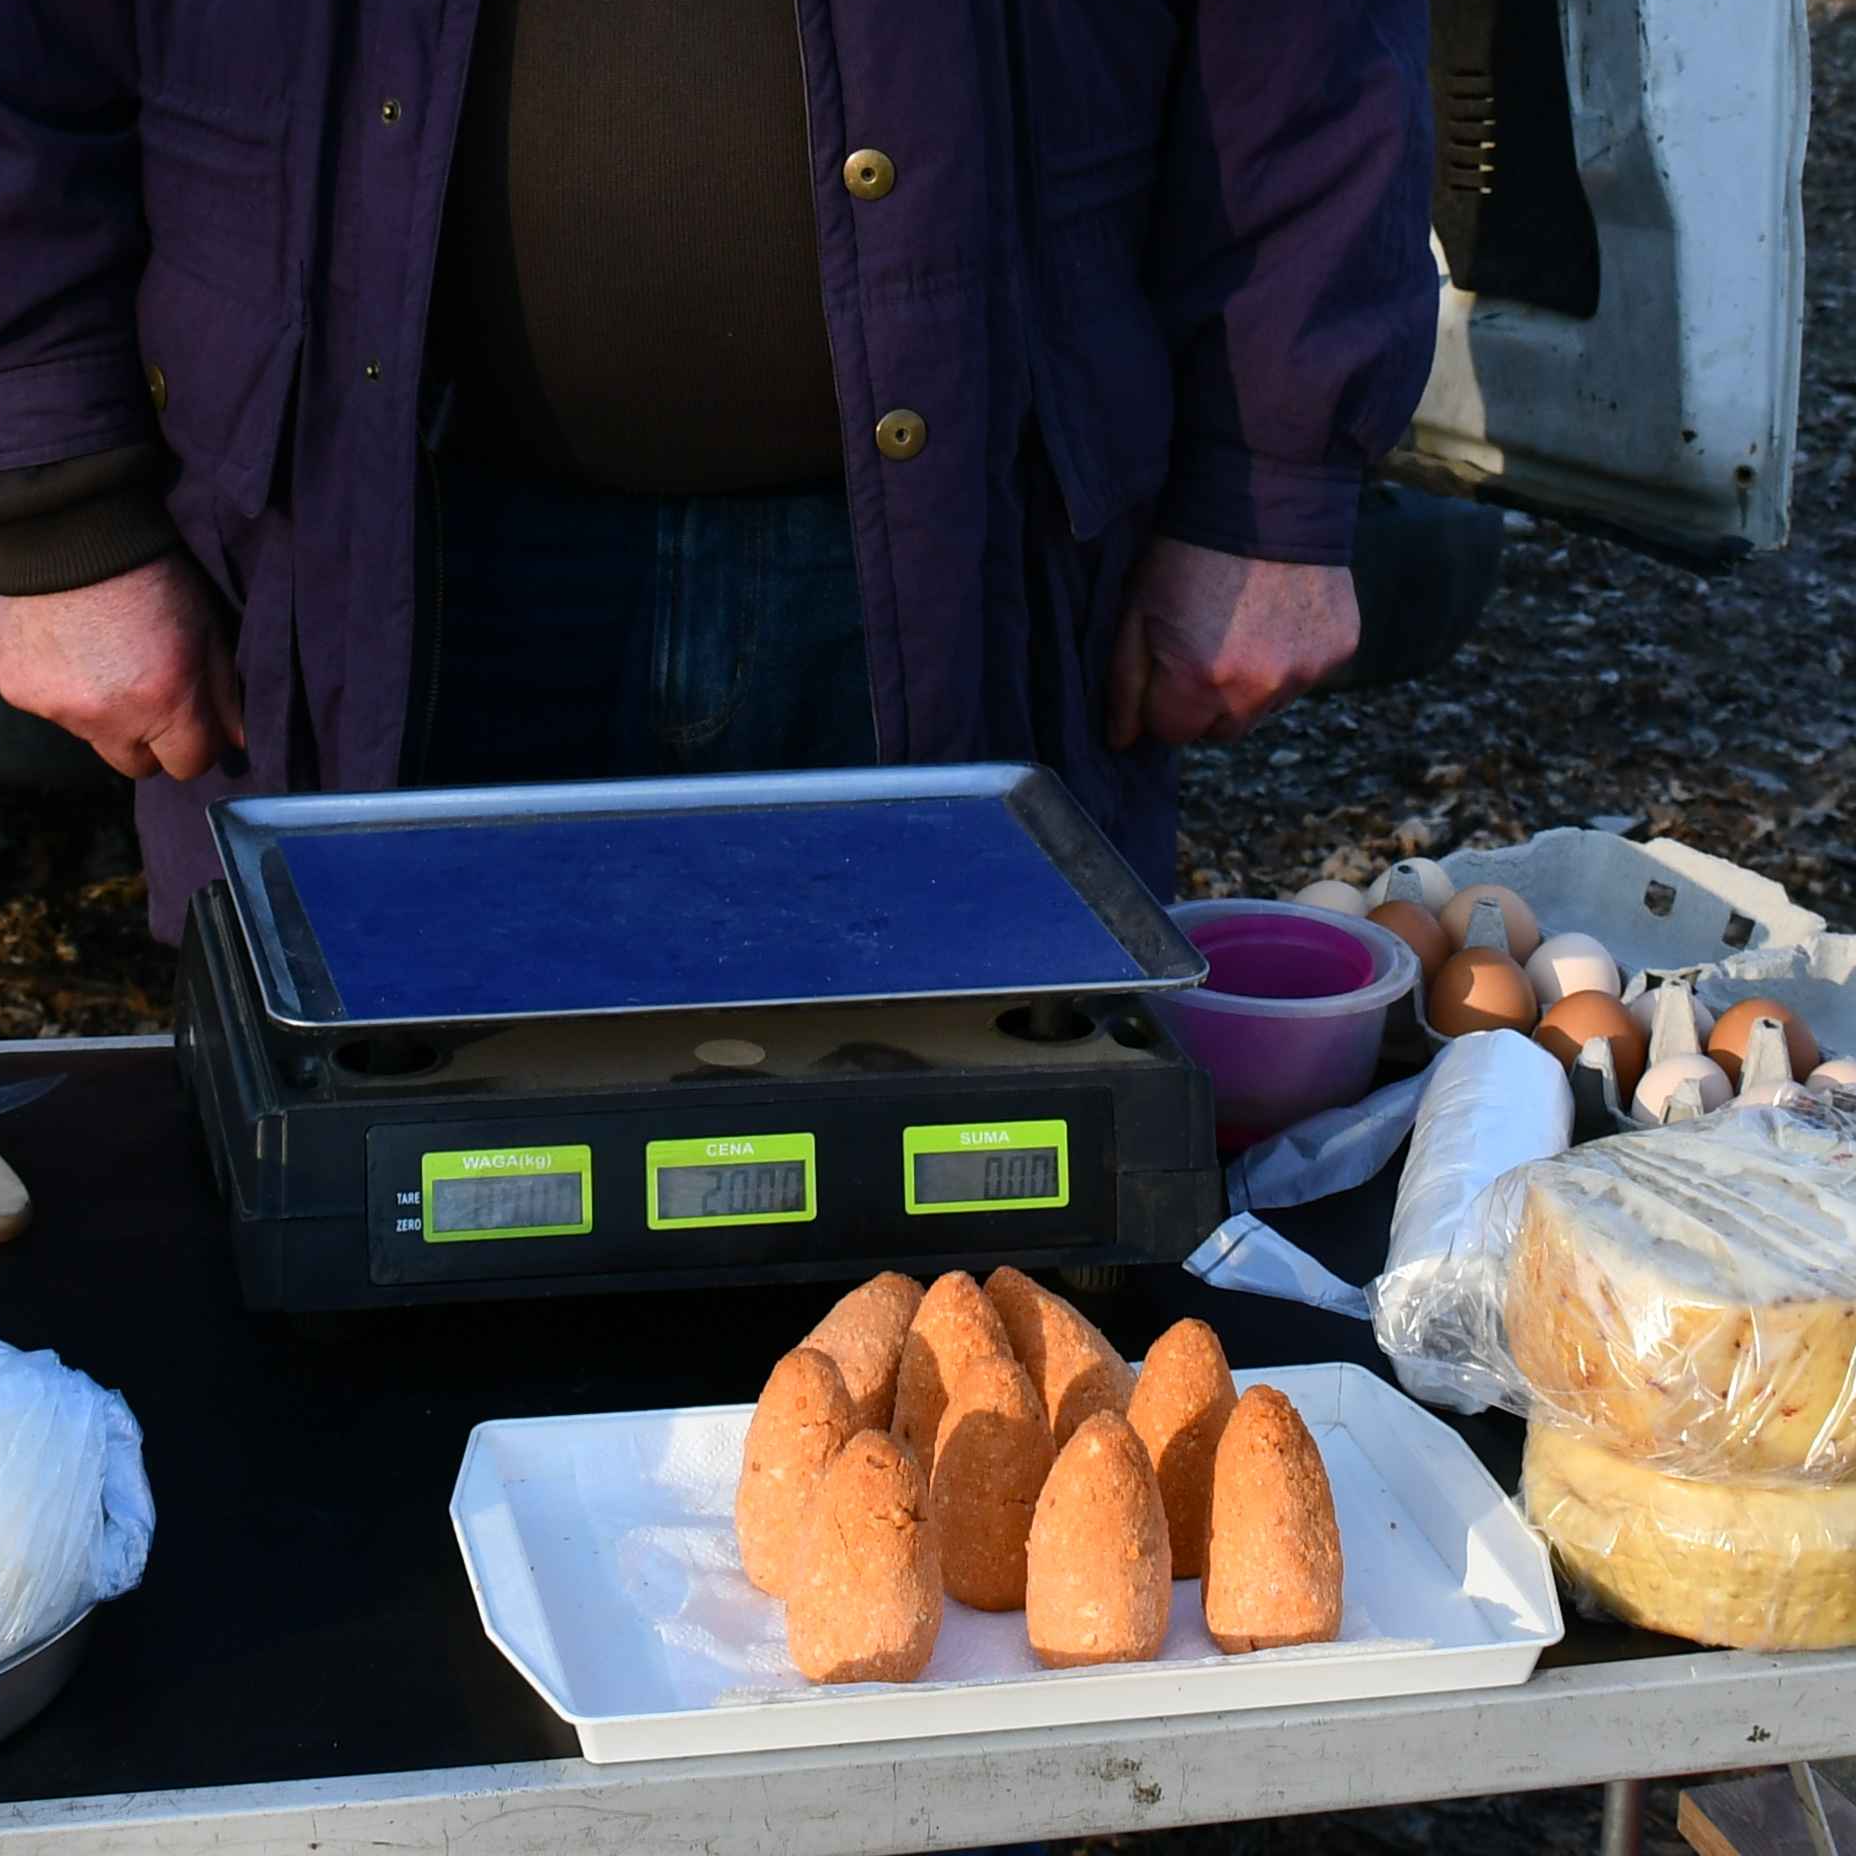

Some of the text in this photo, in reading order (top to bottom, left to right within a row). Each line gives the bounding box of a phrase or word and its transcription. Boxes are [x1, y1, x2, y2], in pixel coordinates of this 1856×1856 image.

[959, 1130, 1010, 1145] SUMA
[705, 1142, 755, 1157] CENA
[462, 1153, 553, 1170] WAGA(kg)
[397, 1192, 421, 1205] TARE
[396, 1218, 422, 1232] ZERO
